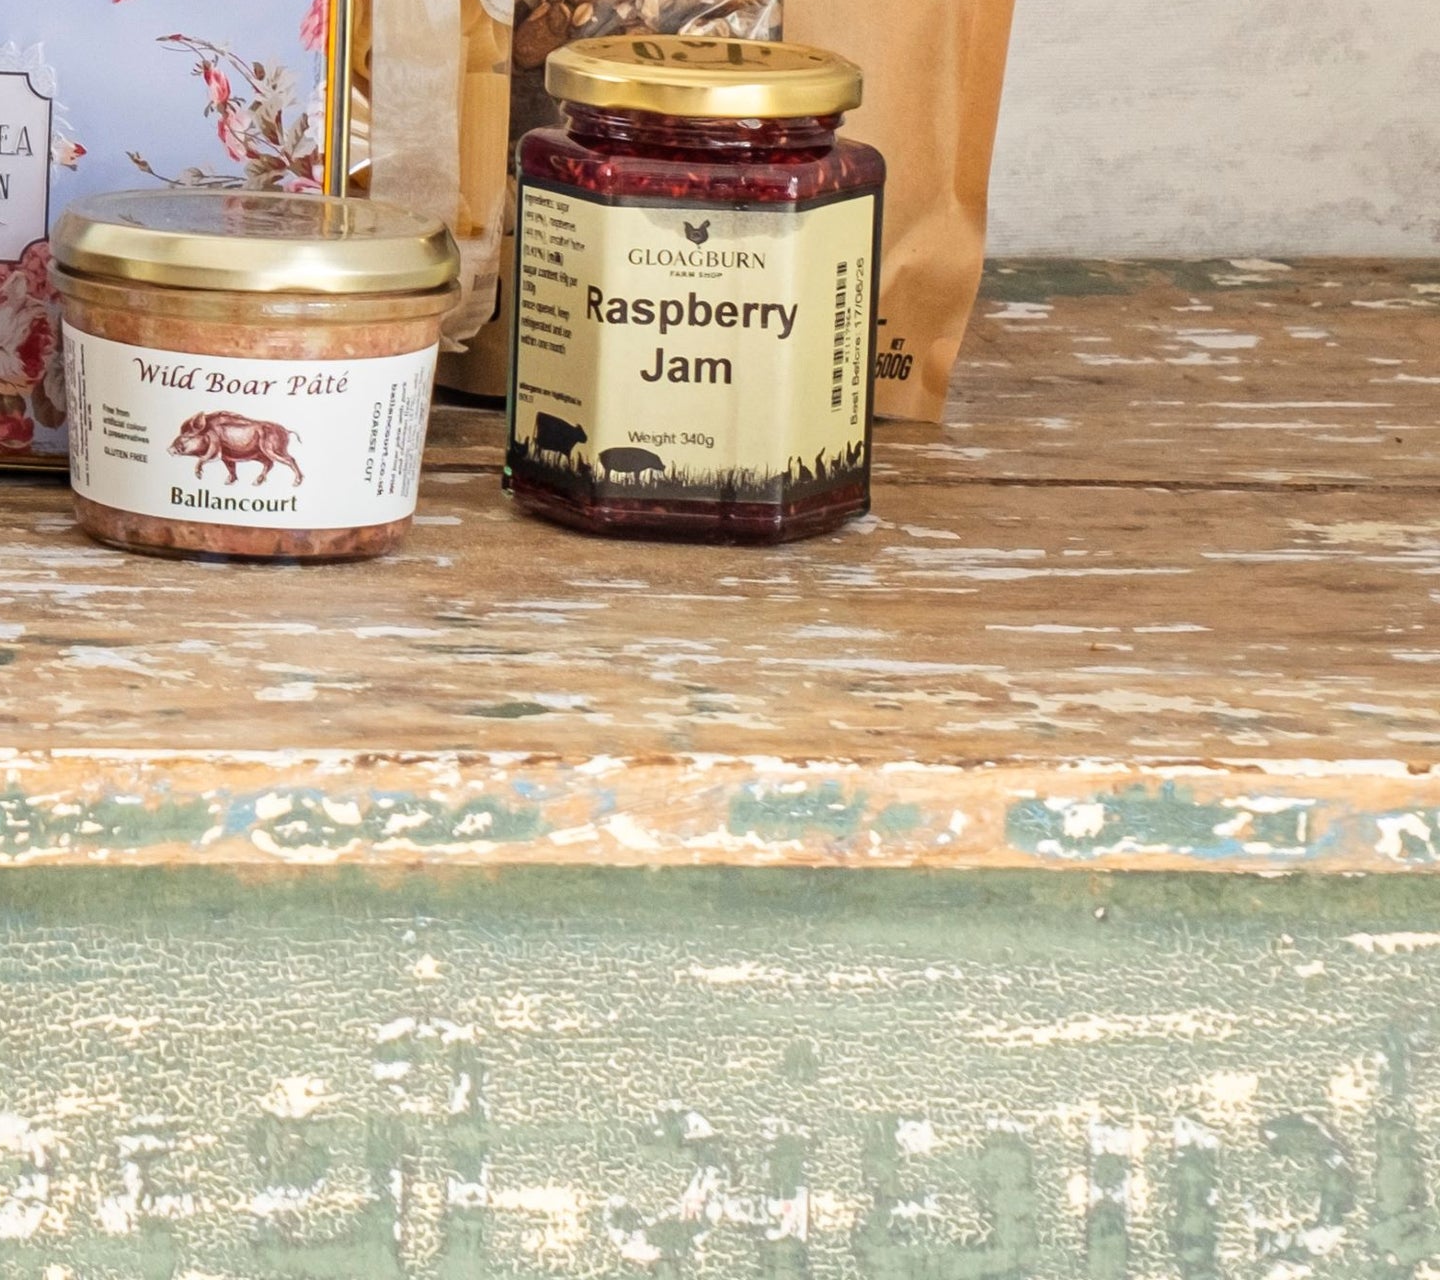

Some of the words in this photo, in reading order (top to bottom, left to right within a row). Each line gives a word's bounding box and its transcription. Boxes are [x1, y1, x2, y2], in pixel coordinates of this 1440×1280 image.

[628, 248, 767, 269] GLOAGBURN
[586, 284, 799, 340] Raspberry
[133, 357, 203, 390] Wild
[206, 372, 277, 395] Boar
[287, 370, 349, 396] Pâté
[639, 347, 732, 384] Jam
[368, 402, 382, 453] COARSE
[628, 430, 677, 446] Weight
[104, 446, 128, 459] GLUTEN
[363, 458, 374, 483] CUT
[170, 486, 298, 512] Ballancourt
